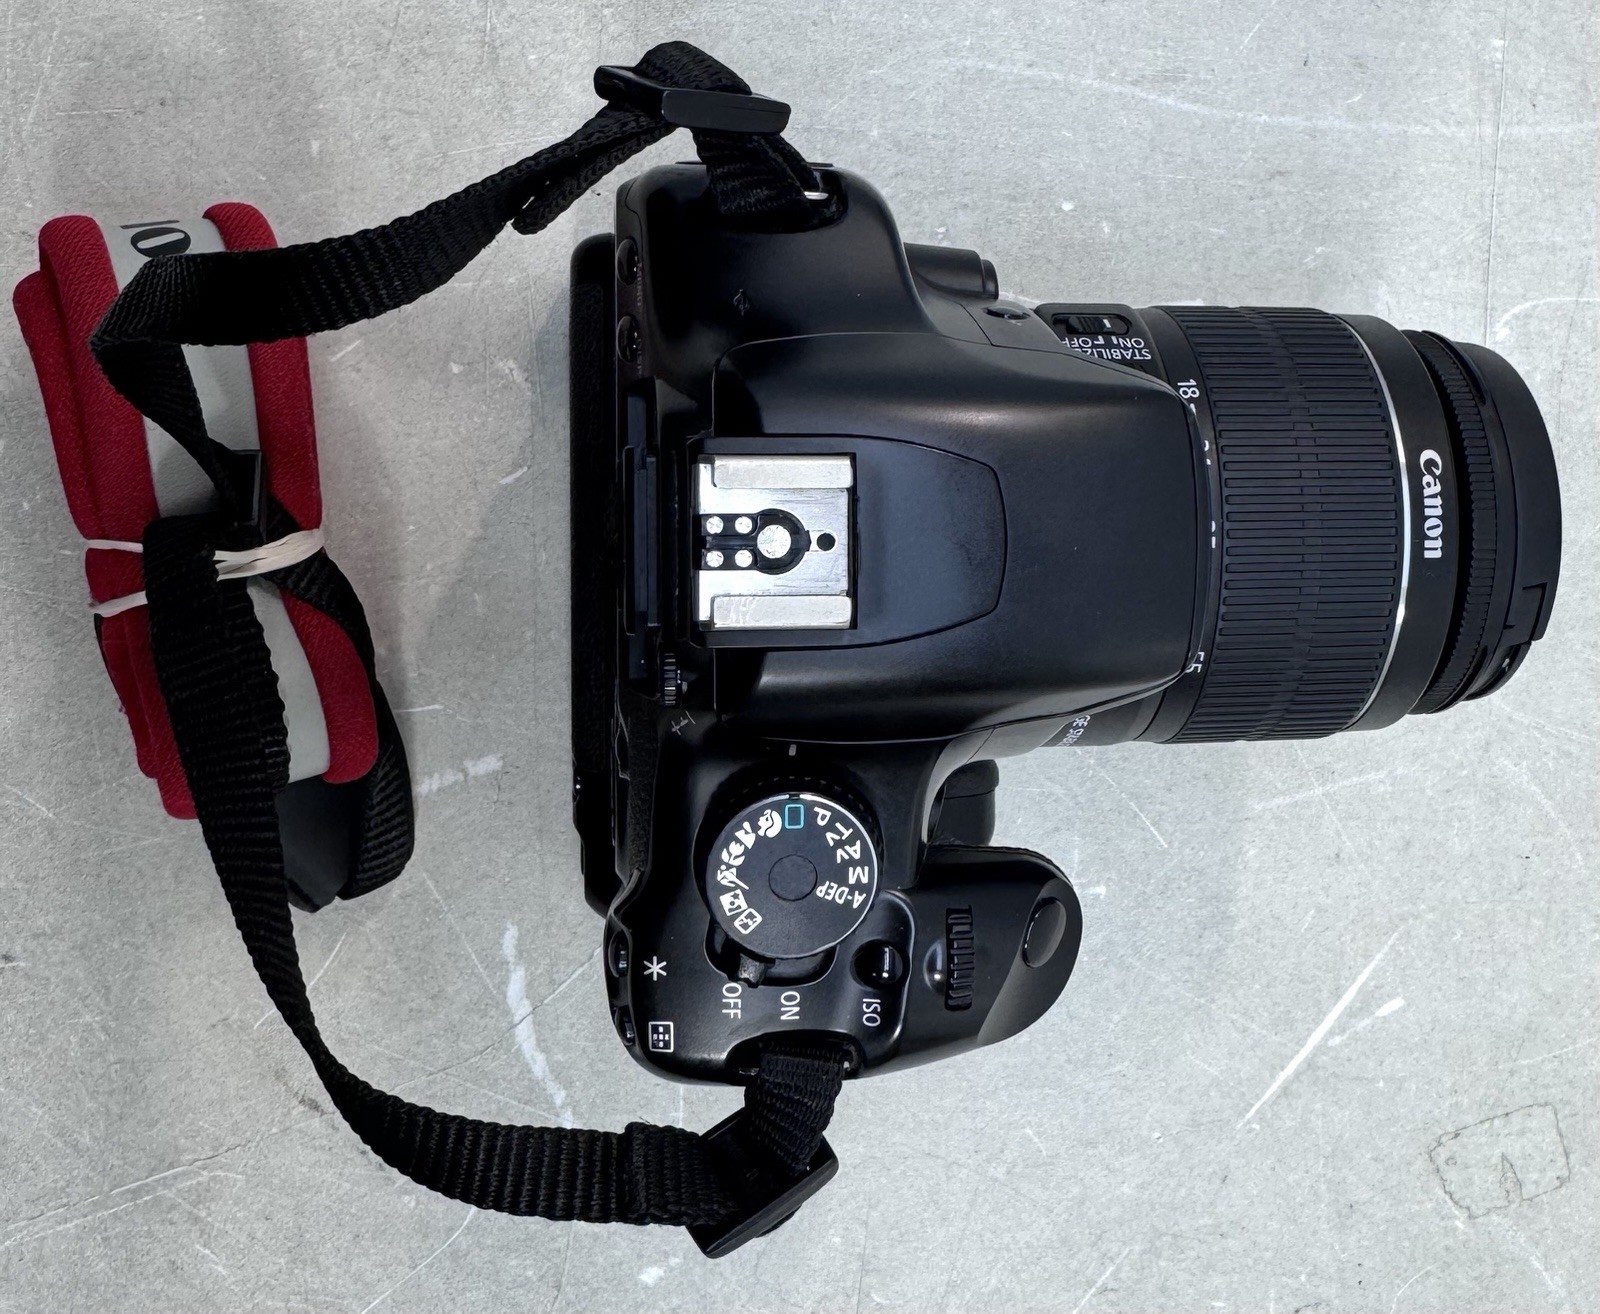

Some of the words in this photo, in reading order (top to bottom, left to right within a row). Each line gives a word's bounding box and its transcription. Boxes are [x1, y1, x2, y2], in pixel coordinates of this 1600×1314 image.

[1074, 348, 1152, 360] STABILIZ
[1120, 337, 1145, 348] ON
[1177, 378, 1200, 399] 18
[1420, 449, 1443, 559] Canon
[814, 806, 831, 826] P
[848, 866, 869, 885] M
[815, 880, 867, 909] A-DEP
[722, 982, 742, 1020] OFF
[780, 991, 800, 1021] ON
[862, 998, 881, 1027] ISO
